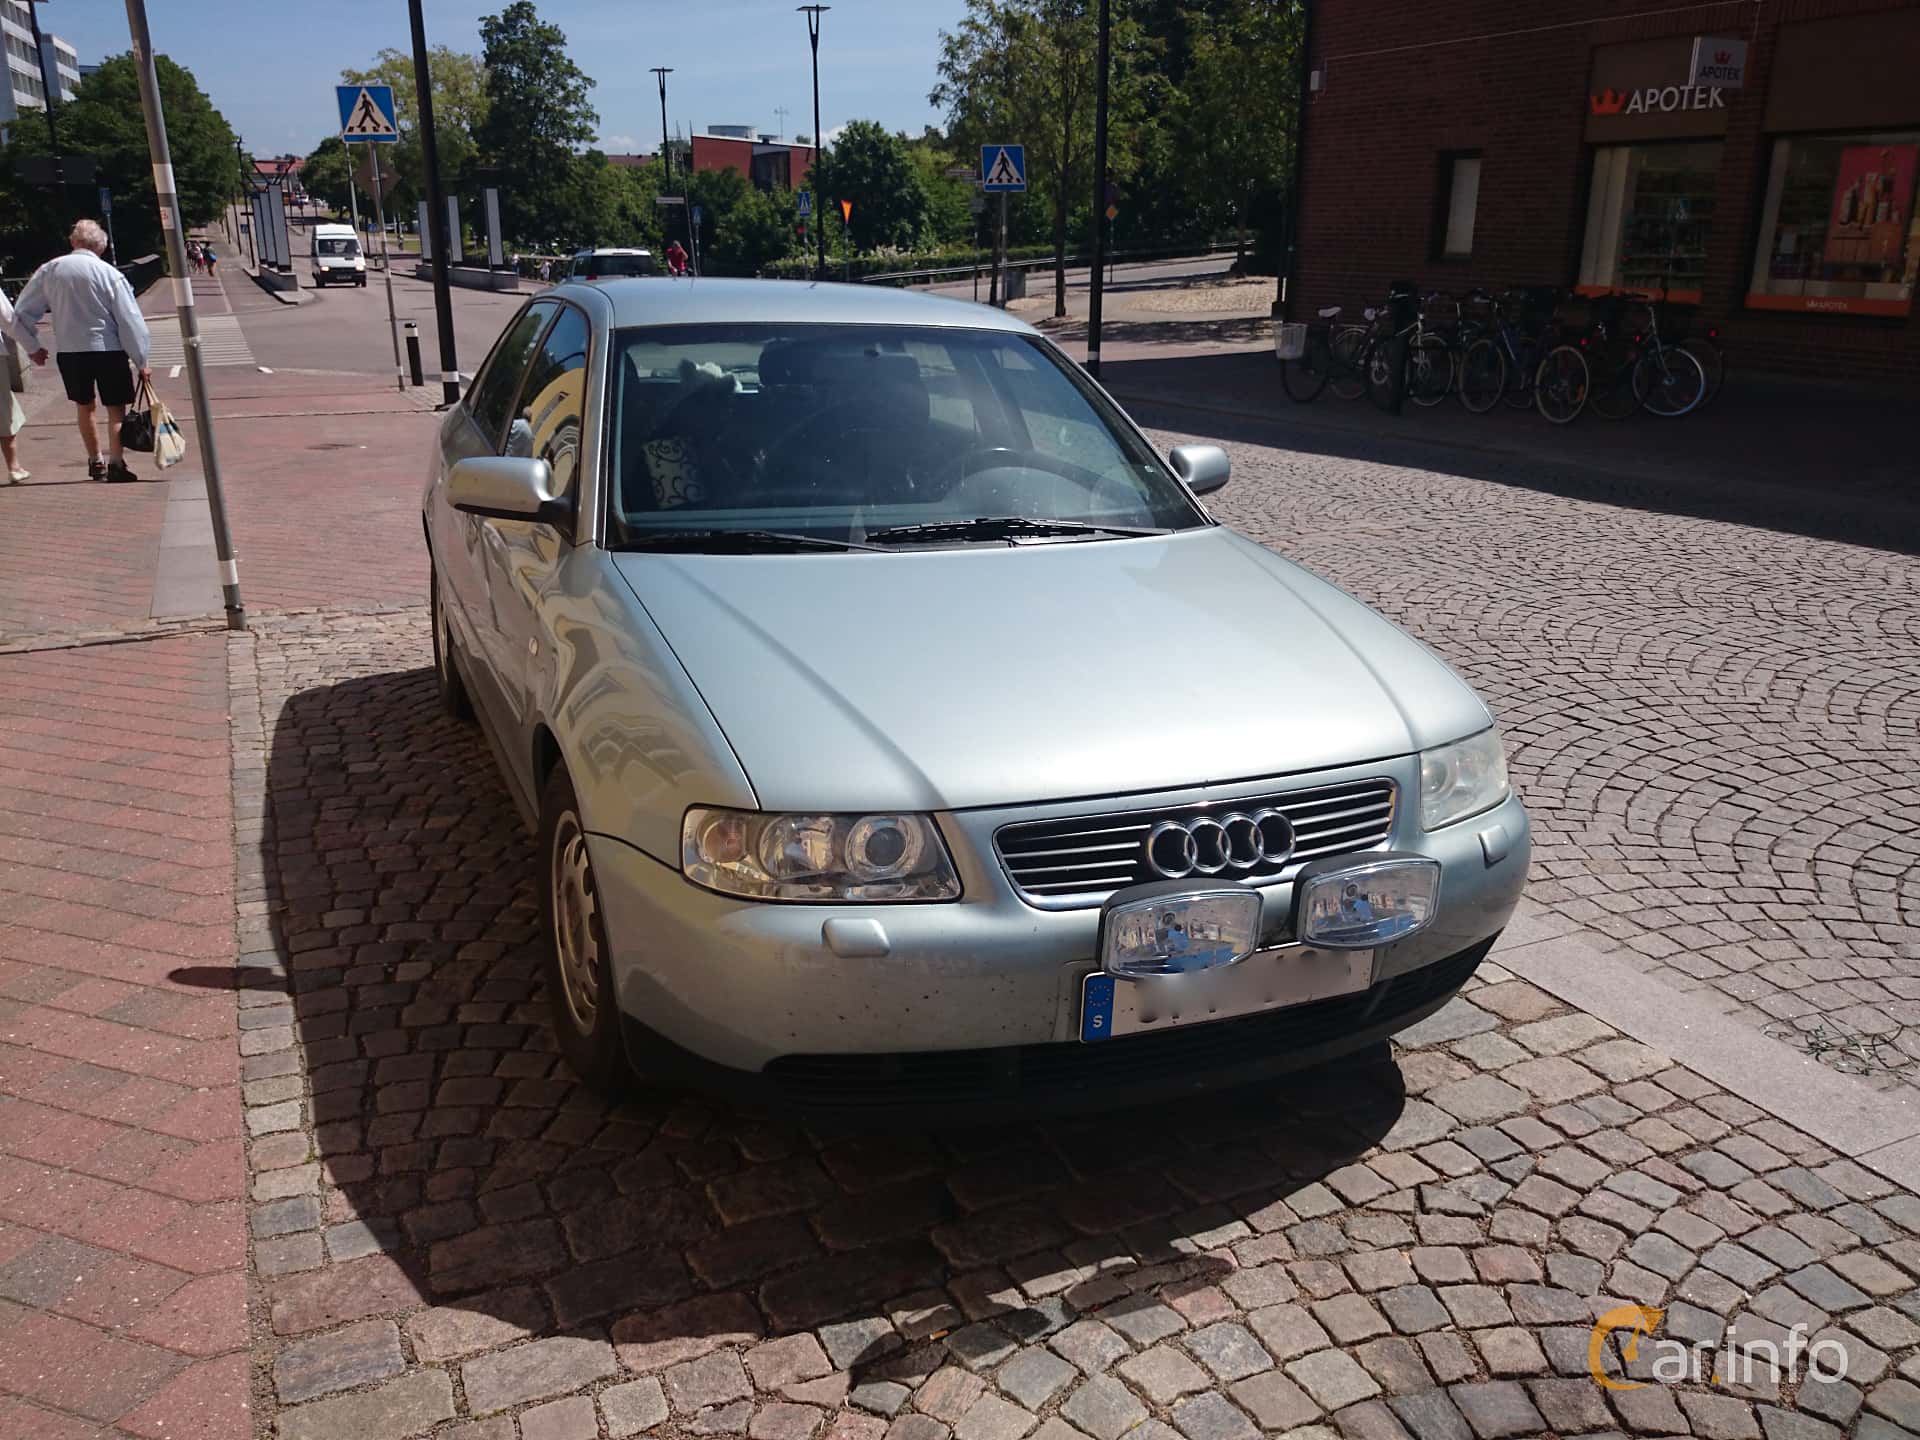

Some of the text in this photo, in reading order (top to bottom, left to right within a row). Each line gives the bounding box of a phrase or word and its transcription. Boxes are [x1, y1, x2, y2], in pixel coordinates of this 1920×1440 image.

[1699, 66, 1741, 81] APOTEK
[1625, 86, 1724, 115] APOTEK
[1092, 1015, 1103, 1028] S
